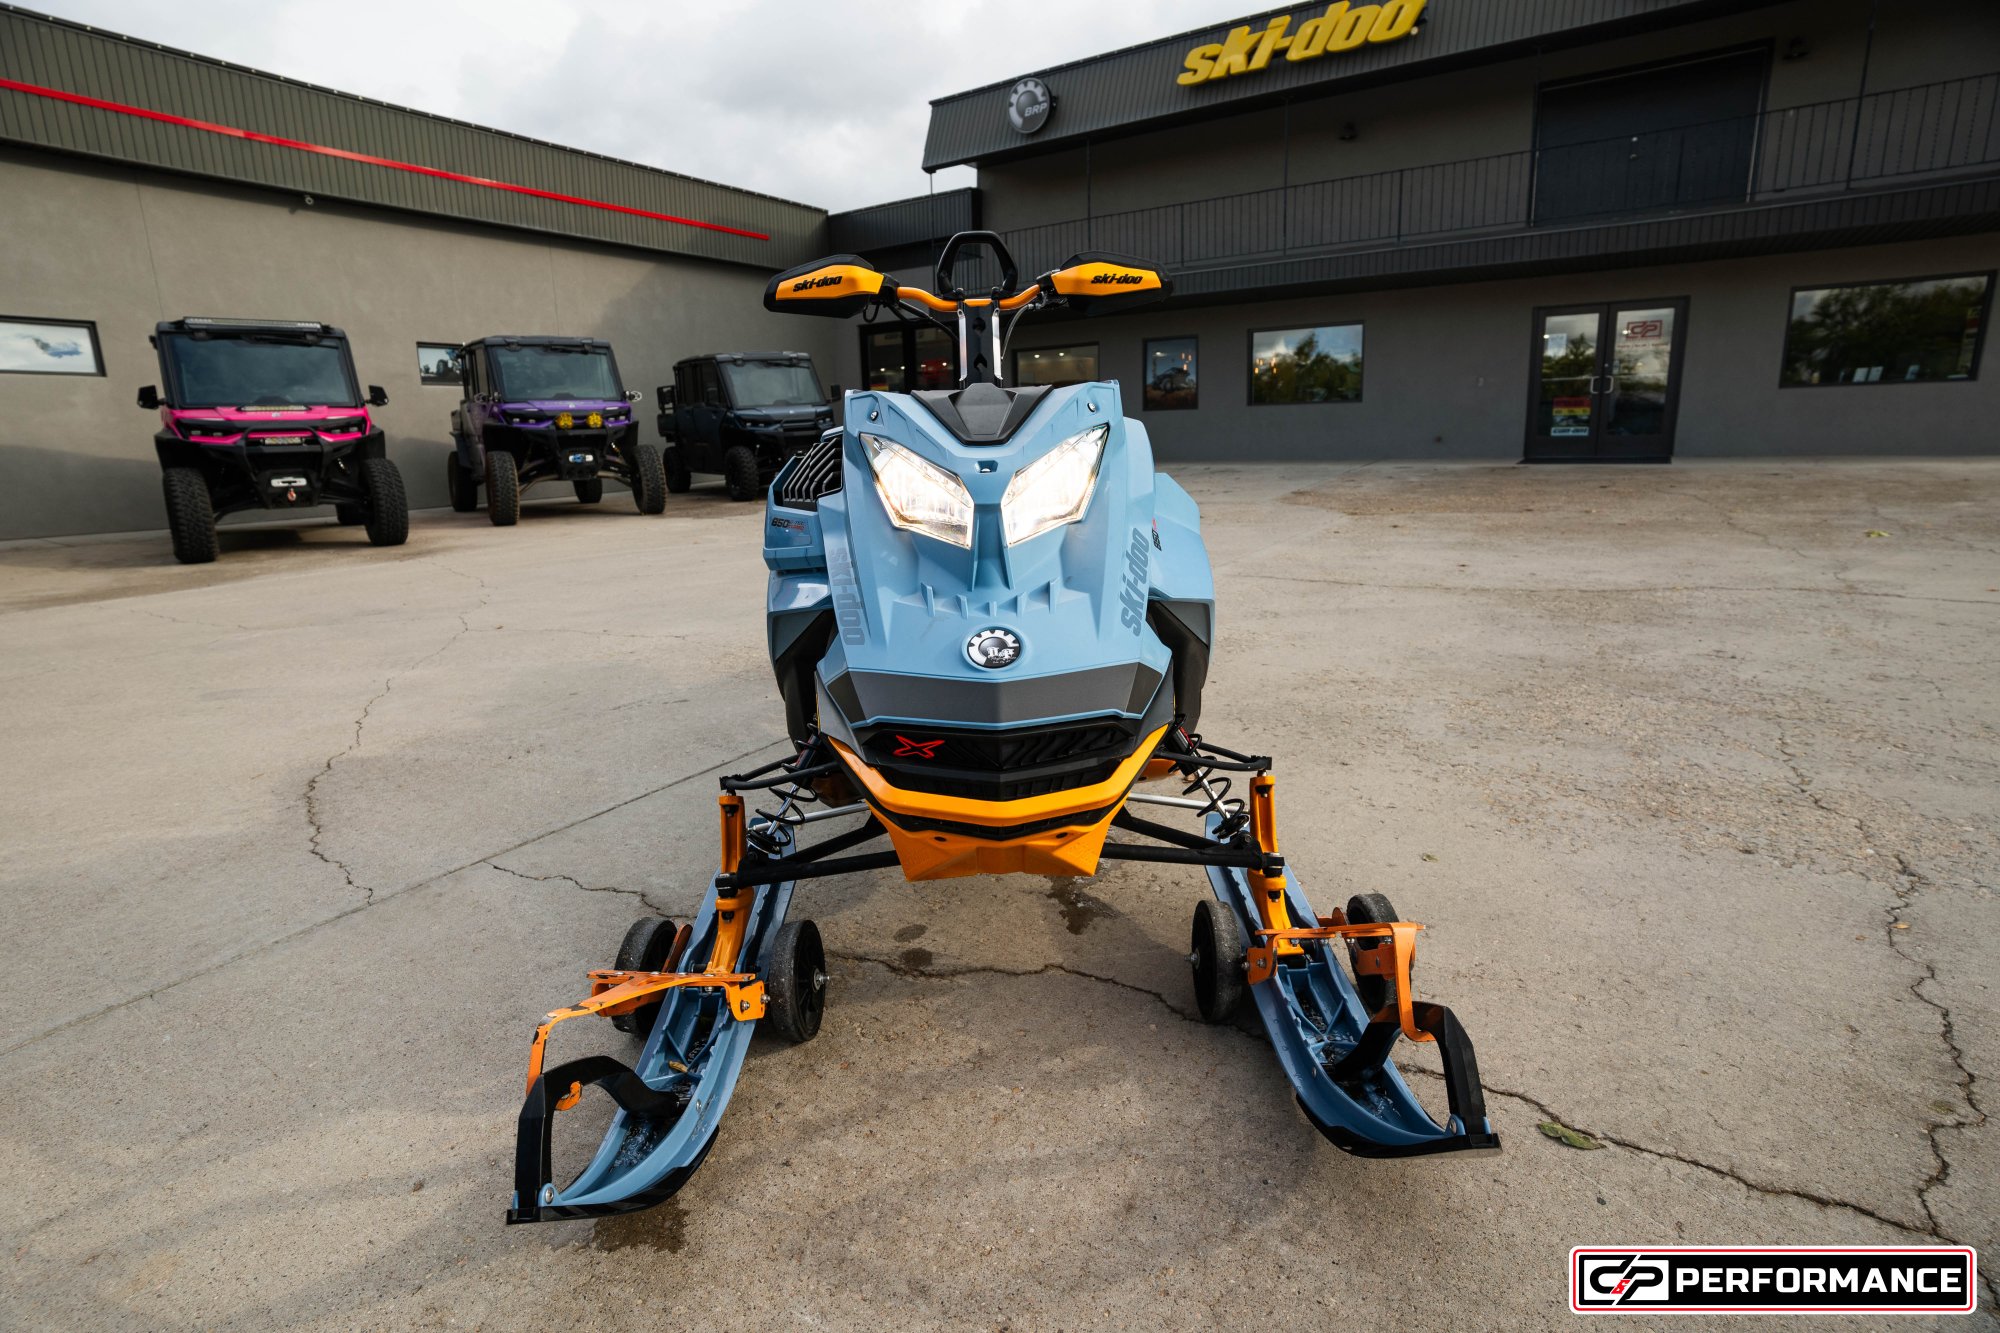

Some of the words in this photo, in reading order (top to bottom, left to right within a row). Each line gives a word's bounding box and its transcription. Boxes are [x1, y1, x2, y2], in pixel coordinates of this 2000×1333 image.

[1177, 0, 1426, 86] ski-doo
[1024, 102, 1048, 117] BRP
[793, 275, 843, 292] ski-doo
[1091, 273, 1143, 284] ski-doo
[771, 516, 790, 529] 850
[1119, 527, 1150, 637] ski-doo
